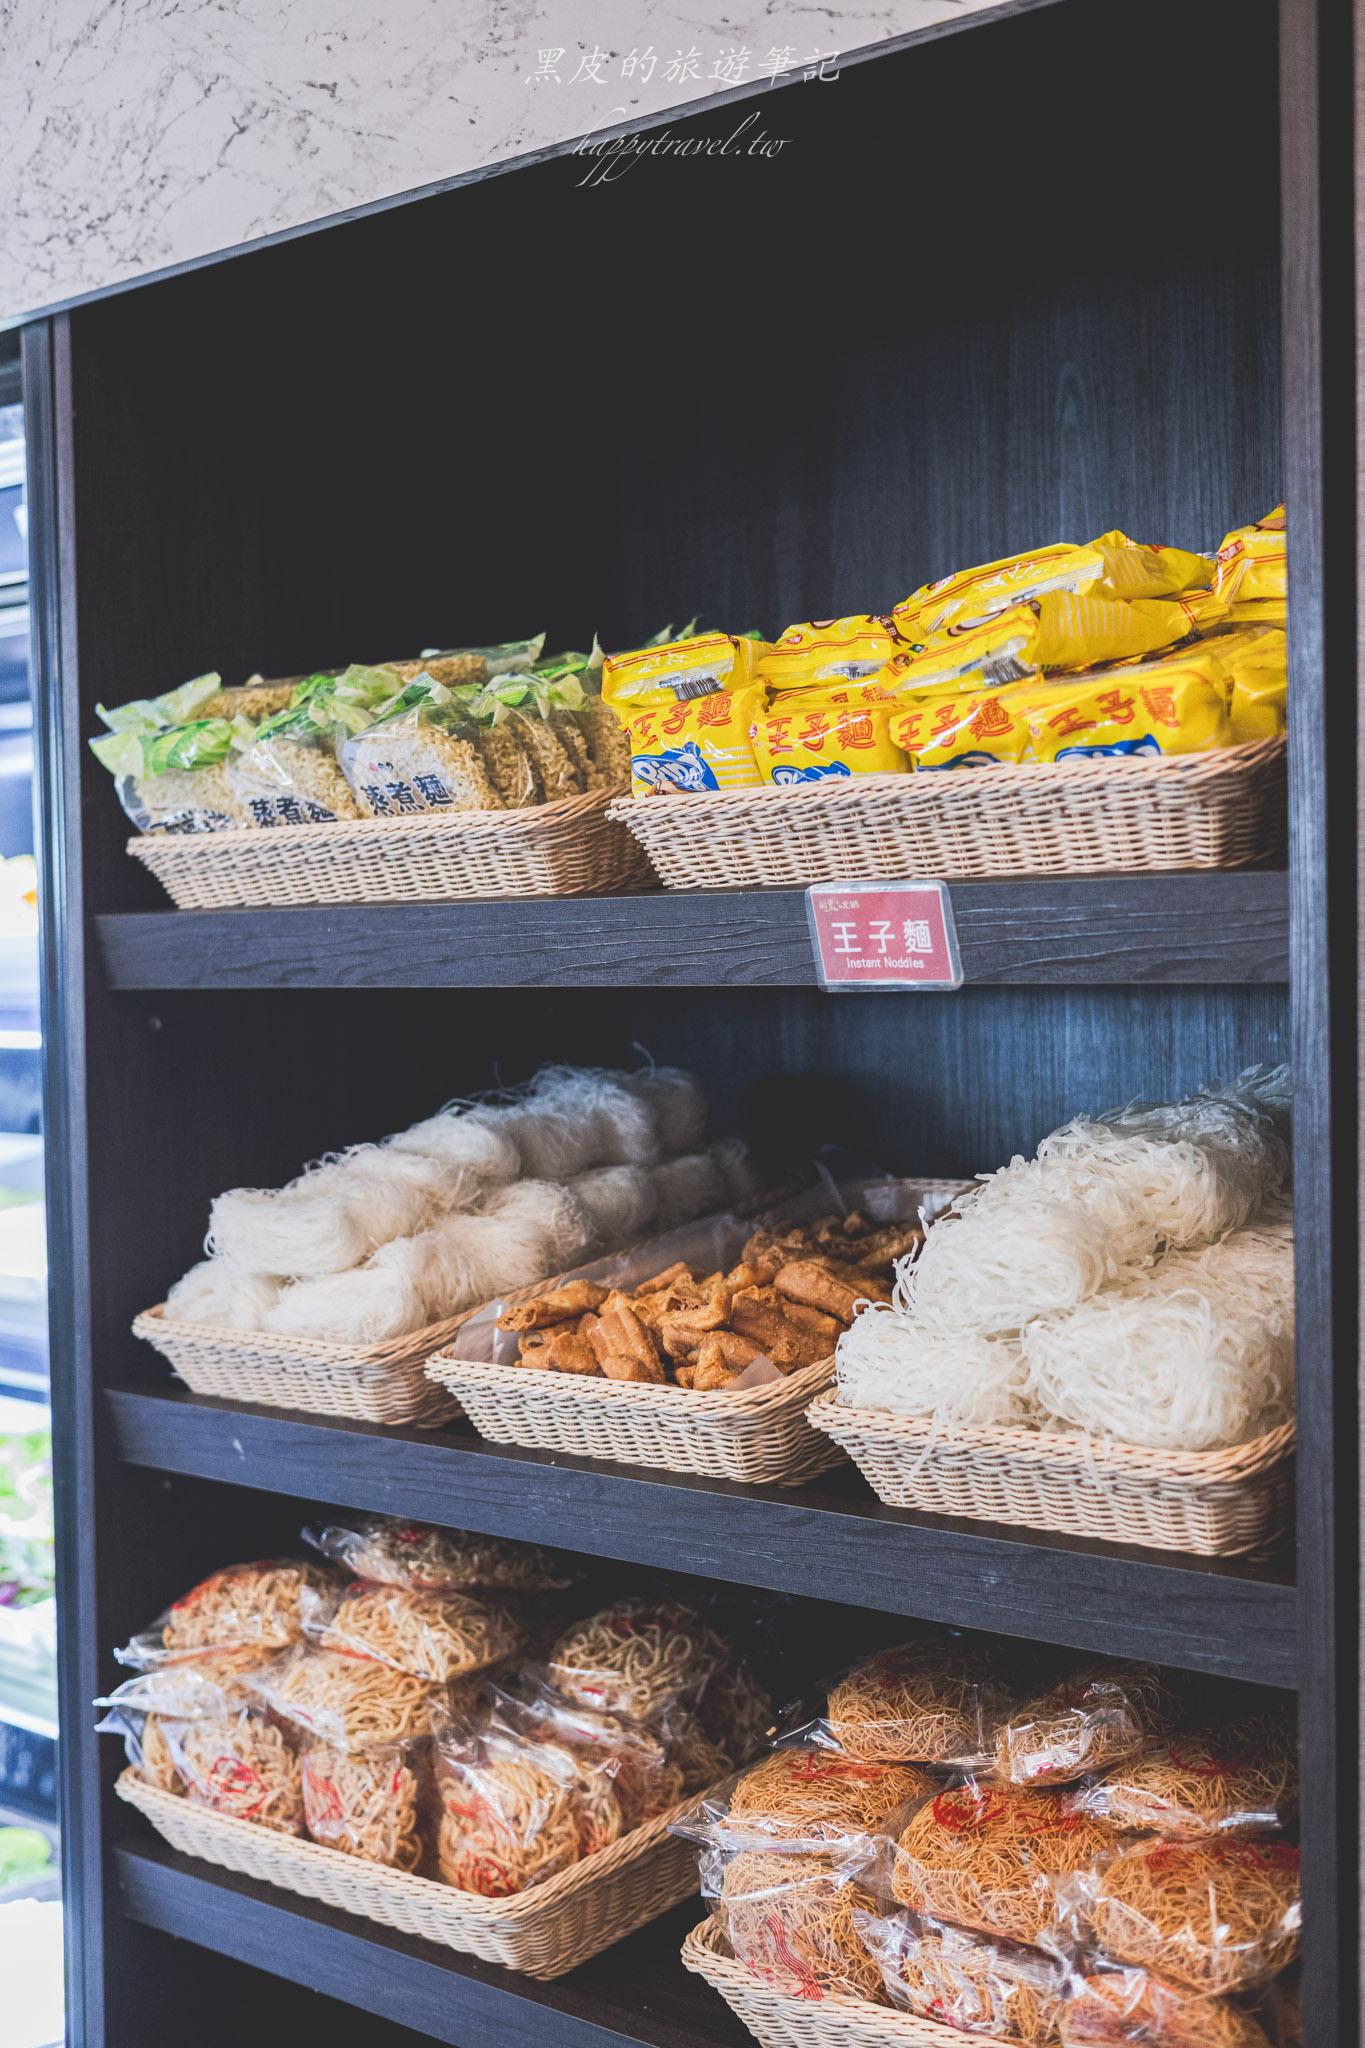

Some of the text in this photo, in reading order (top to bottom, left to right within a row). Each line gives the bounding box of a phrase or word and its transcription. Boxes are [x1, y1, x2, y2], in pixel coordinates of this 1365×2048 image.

[633, 692, 733, 748] 王子麵
[769, 710, 876, 756] 王子麵
[898, 697, 1014, 751] 王子麵
[1048, 687, 1180, 737] 王子麵
[360, 774, 454, 816] 蒸煮麵
[831, 919, 933, 954] 王子麵
[847, 957, 881, 969] Instant
